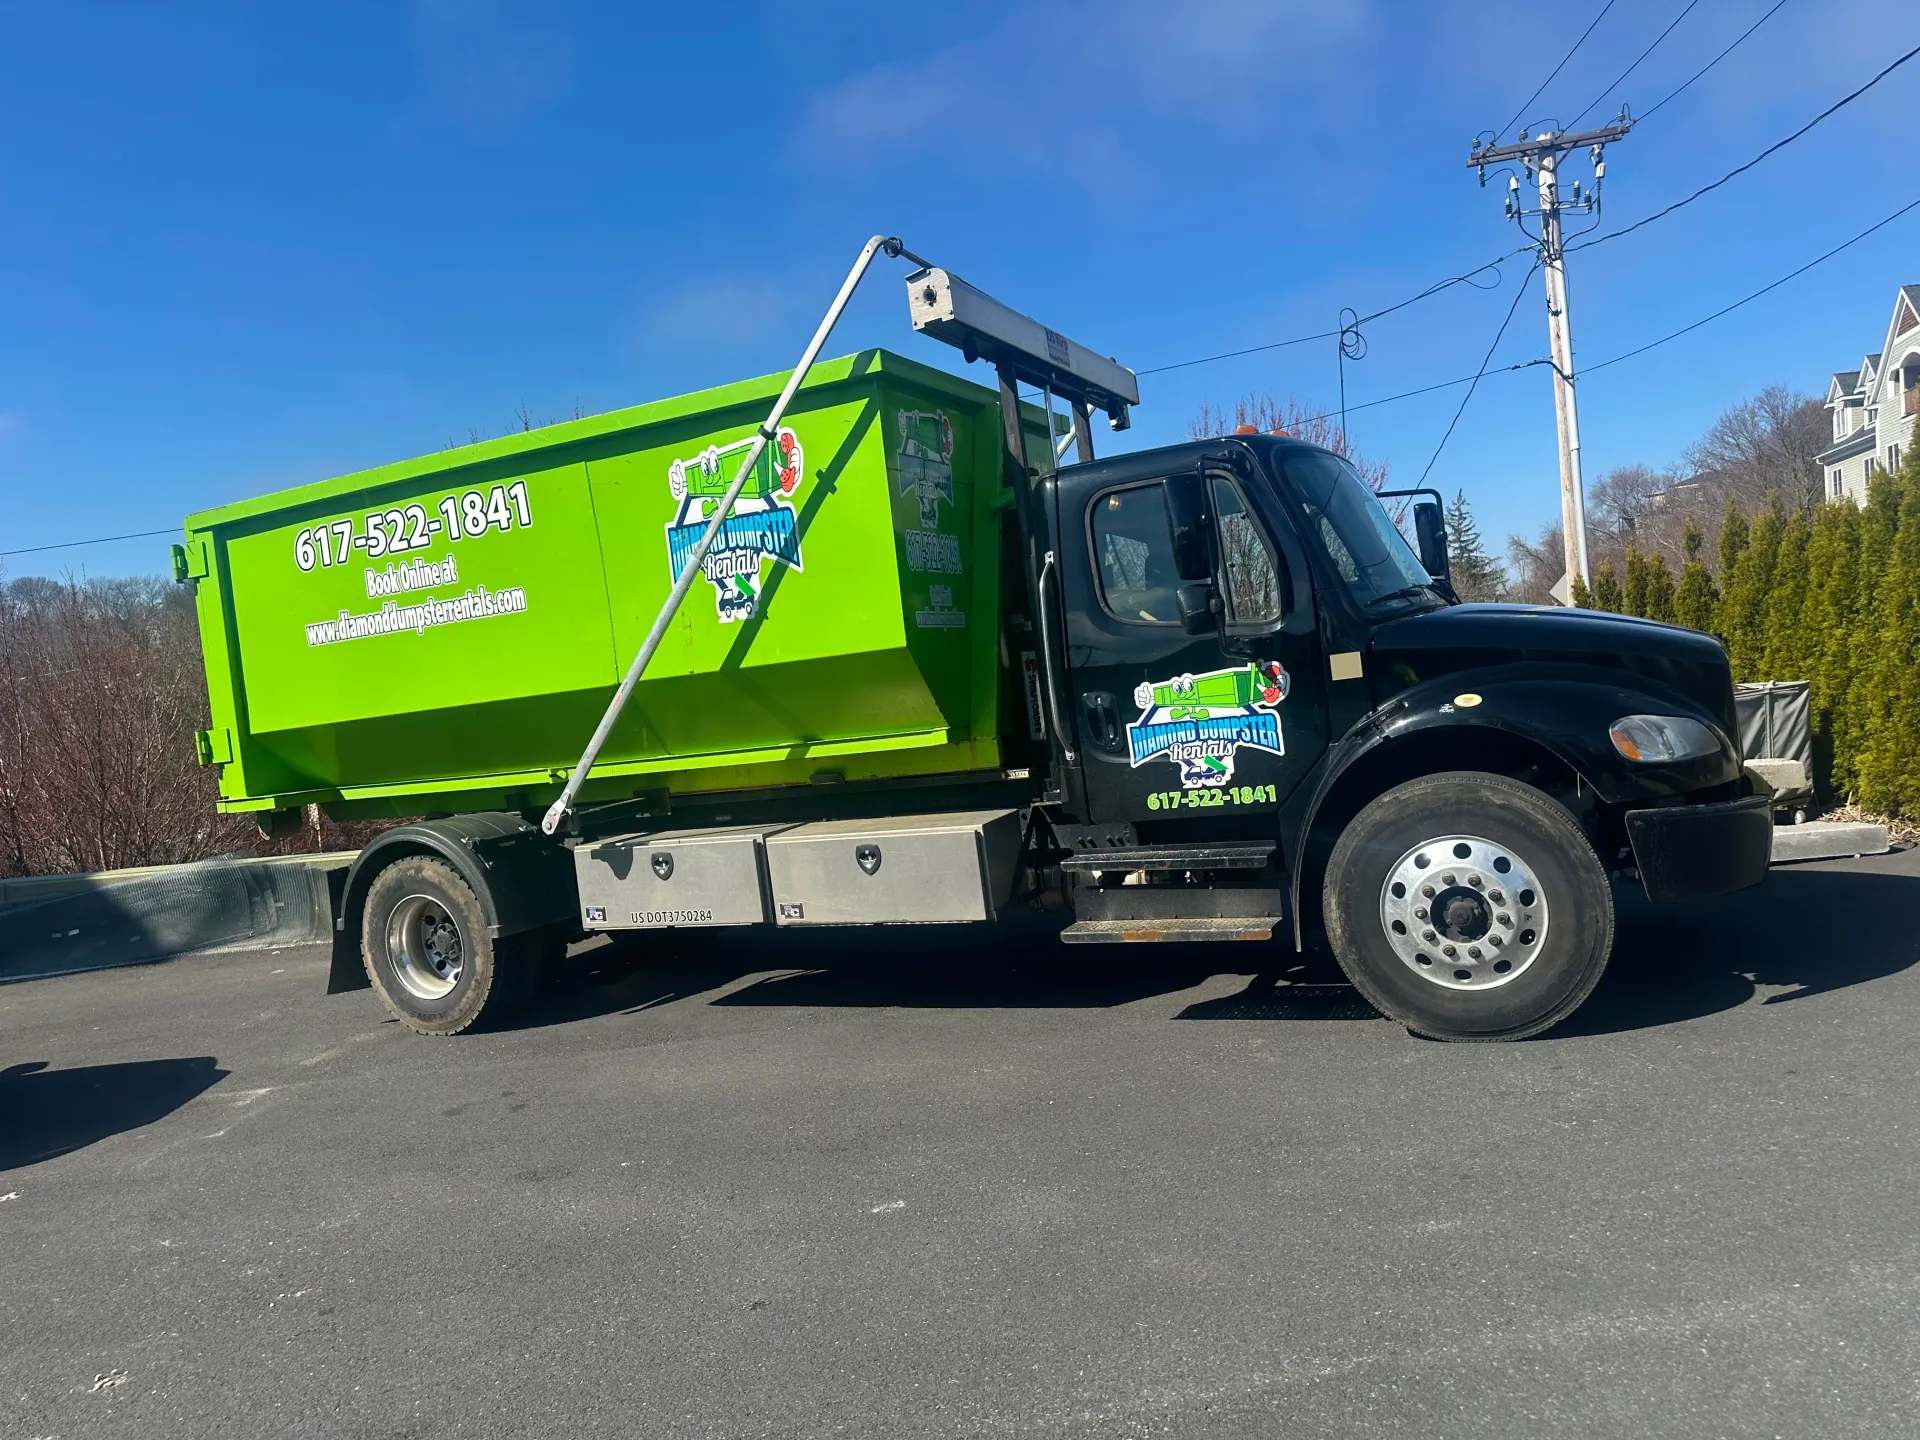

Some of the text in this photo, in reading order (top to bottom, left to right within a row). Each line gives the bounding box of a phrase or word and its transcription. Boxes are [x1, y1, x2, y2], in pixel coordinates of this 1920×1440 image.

[295, 481, 531, 571] 617-522-1841
[727, 510, 798, 562] DUMPSTER
[366, 554, 458, 597] Book Online at
[704, 549, 759, 580] Rentals
[306, 586, 526, 646] www.diamonddumpsterrentals.com
[1131, 715, 1280, 761] DIAMOND DUMPSTER
[1170, 740, 1233, 760] Rentals
[1147, 785, 1276, 810] 617-522-1841
[631, 909, 713, 924] US DOT3750284
